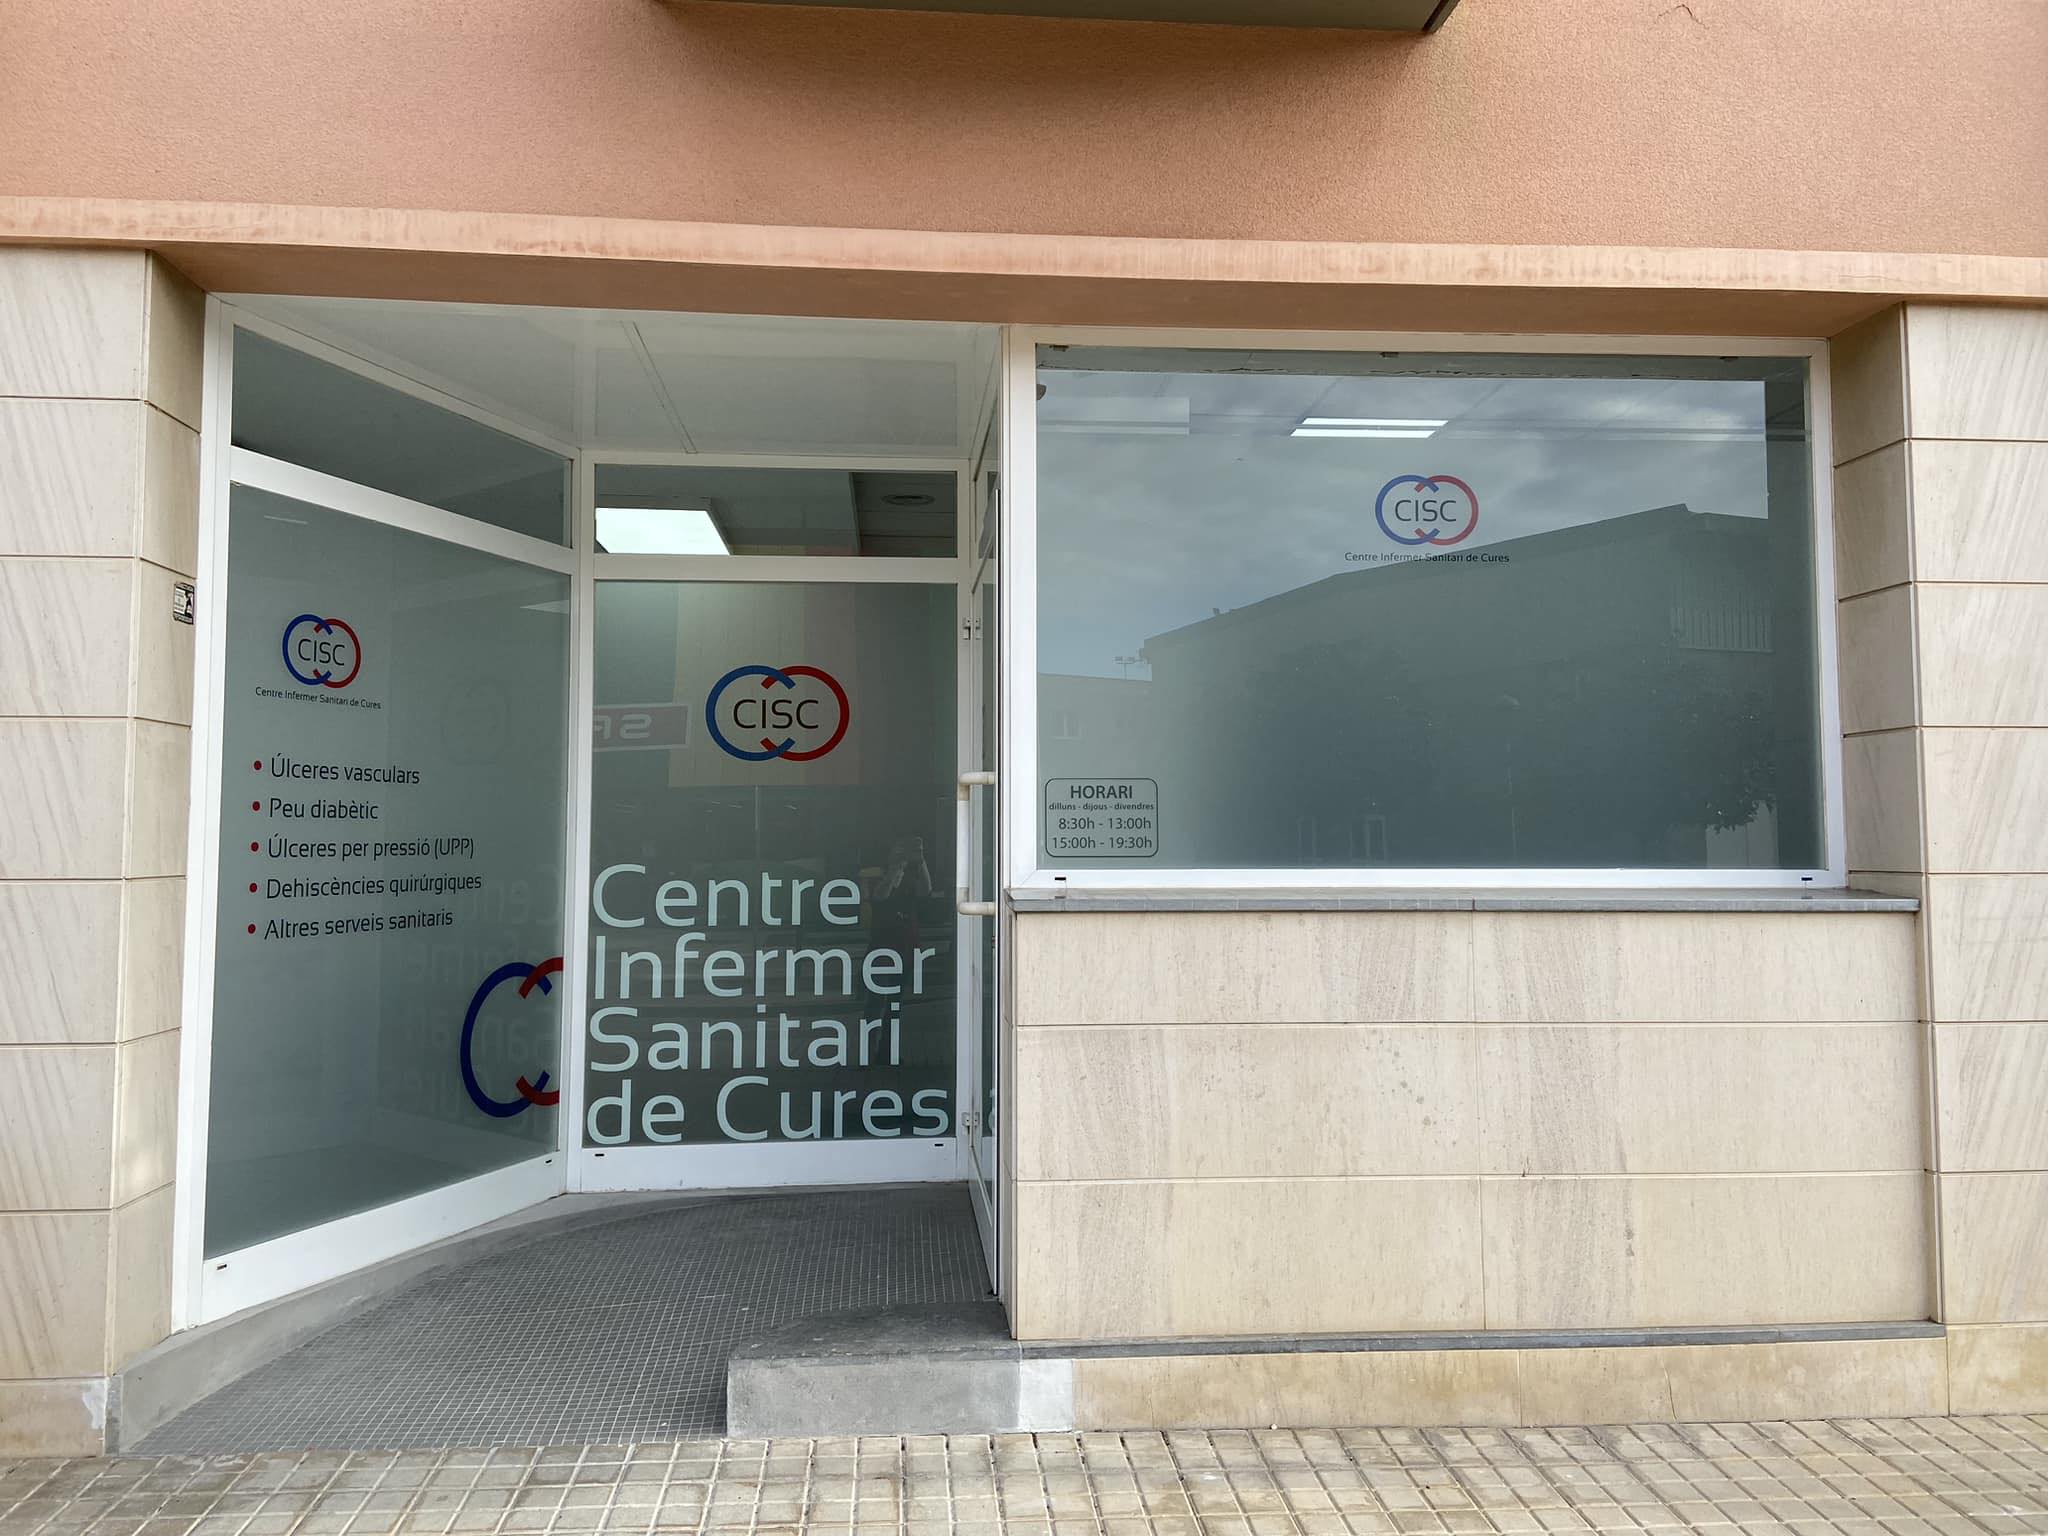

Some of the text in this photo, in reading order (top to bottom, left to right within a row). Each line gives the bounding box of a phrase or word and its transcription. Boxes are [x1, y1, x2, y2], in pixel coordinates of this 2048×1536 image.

[1395, 499, 1457, 522] CISC
[1344, 551, 1510, 563] Centre Infermer Sanitari de Cures
[297, 638, 345, 666] CISC
[255, 686, 382, 710] Centre Infermer Sanitari de Cures
[733, 699, 819, 729] CISC
[271, 752, 420, 784] Úlceres vasculars
[1070, 785, 1133, 799] HORARI
[269, 798, 379, 820] Peu diabètic
[1048, 802, 1076, 811] dilluns
[1082, 802, 1108, 812] dijous
[1114, 802, 1154, 811] divendres
[1058, 817, 1095, 830] 8:30h
[1108, 817, 1152, 830] 13:00h
[267, 833, 474, 862] Úlceres per pressió (UPP)
[1052, 836, 1096, 849] 15:00h
[1109, 836, 1152, 849] 19:30h
[266, 873, 482, 899] Dehiscències quirúrgiques
[592, 863, 861, 928] Centre
[264, 908, 453, 940] Altres serveis sanitaris
[594, 932, 936, 1000] Infermer
[589, 1001, 901, 1072] Sanitari
[586, 1079, 685, 1145] de
[716, 1075, 950, 1141] Cures
